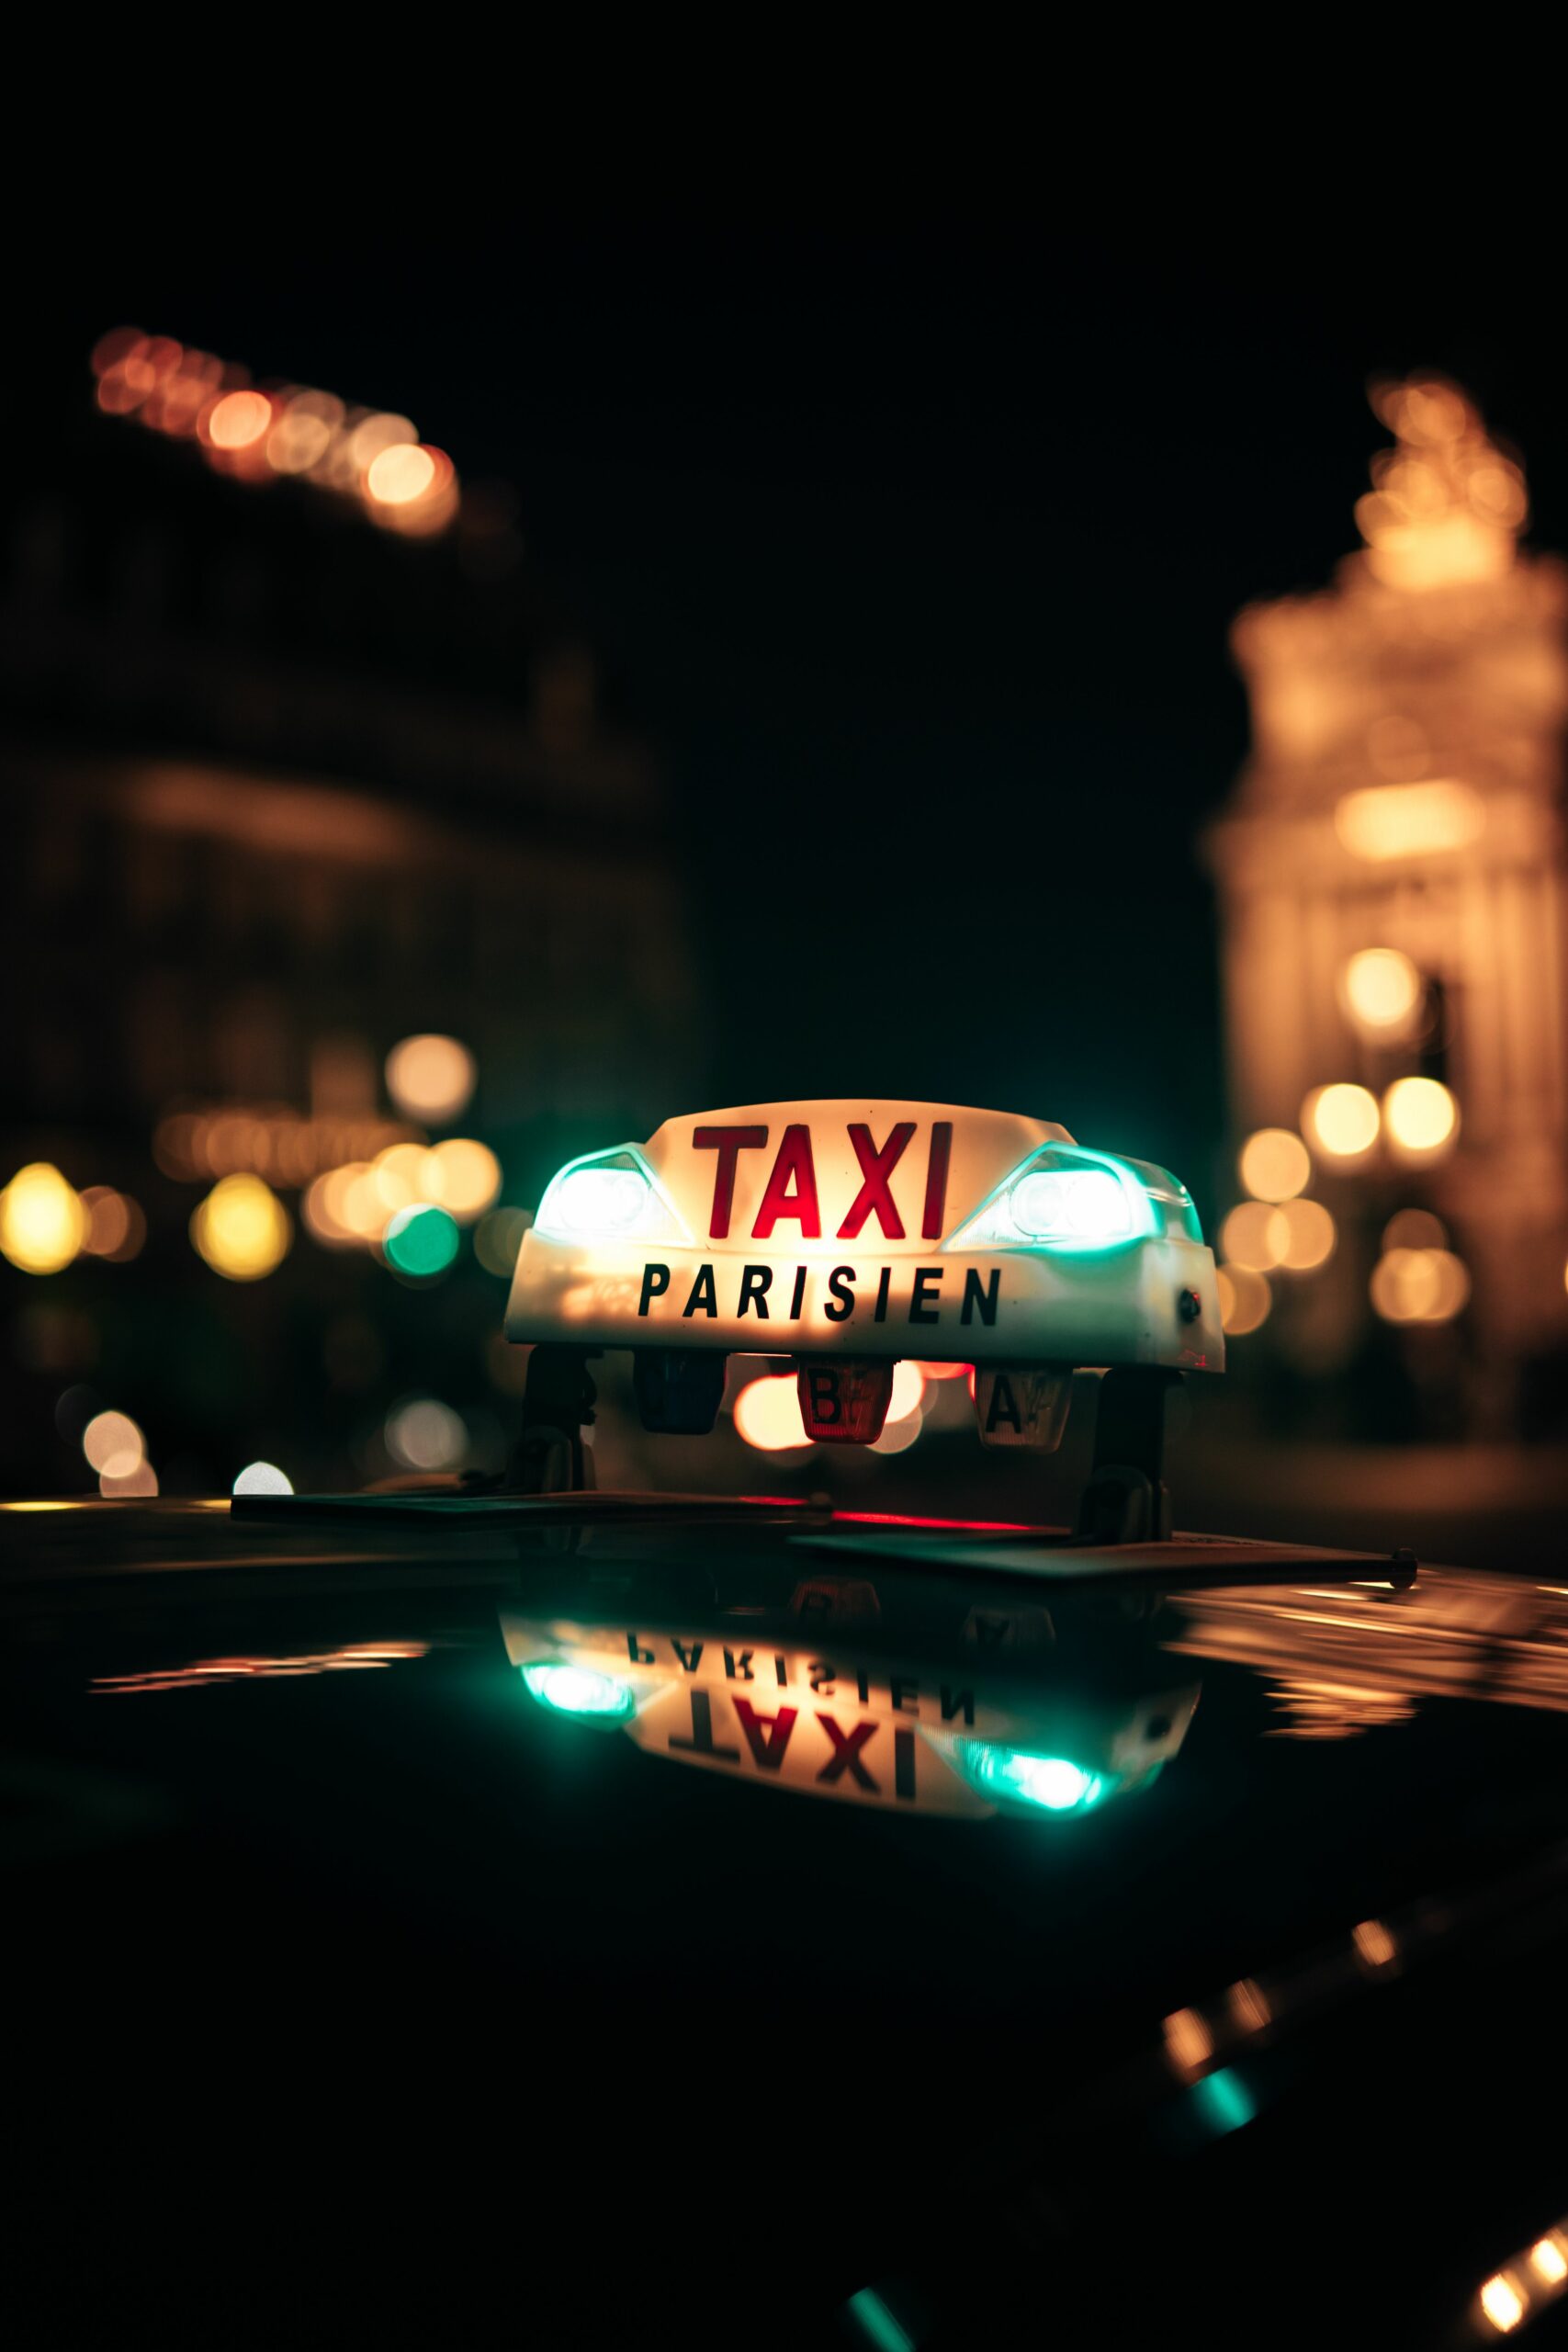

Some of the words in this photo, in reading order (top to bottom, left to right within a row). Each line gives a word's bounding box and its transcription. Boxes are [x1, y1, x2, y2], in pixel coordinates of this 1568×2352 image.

[693, 1121, 953, 1239] TAXI
[637, 1263, 1001, 1326] PARISIEN
[808, 1368, 842, 1423] B
[986, 1374, 1021, 1433] A
